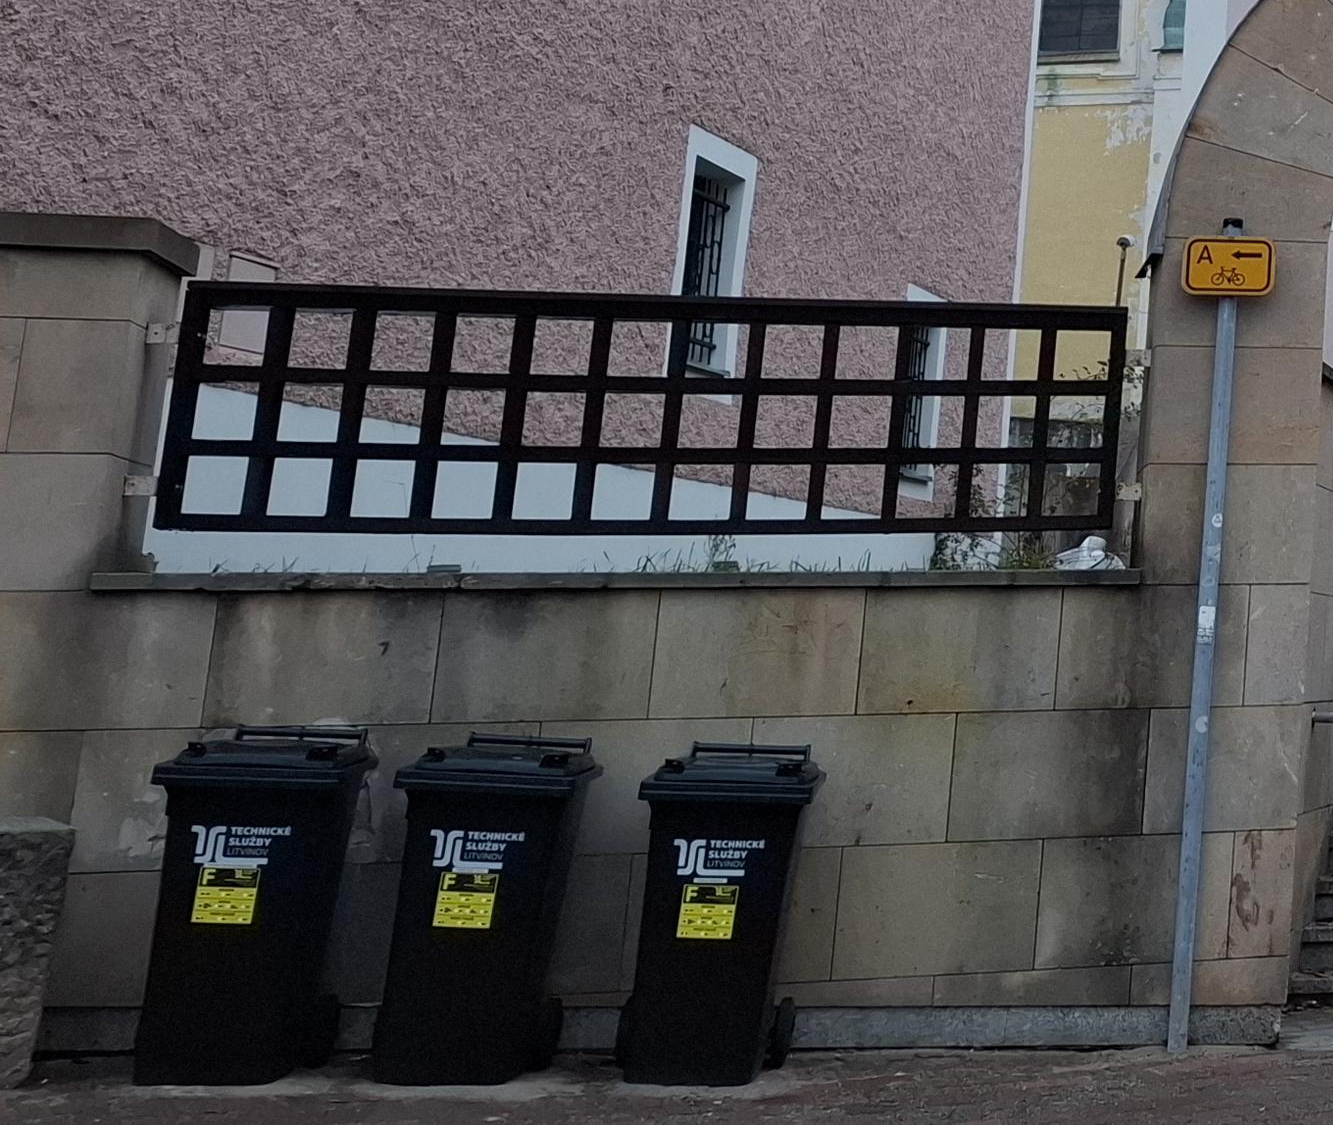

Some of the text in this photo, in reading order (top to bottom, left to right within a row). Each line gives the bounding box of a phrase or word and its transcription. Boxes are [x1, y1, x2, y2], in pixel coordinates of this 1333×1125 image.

[1196, 244, 1213, 264] A
[230, 826, 292, 836] TECHNICKÉ
[228, 836, 272, 847] SLUŽBY
[467, 831, 525, 842] TECHNICKÉ
[465, 841, 507, 851] SLUŽBY
[710, 839, 765, 849] TECHNICKÉ
[708, 849, 748, 859] SLUŽBY
